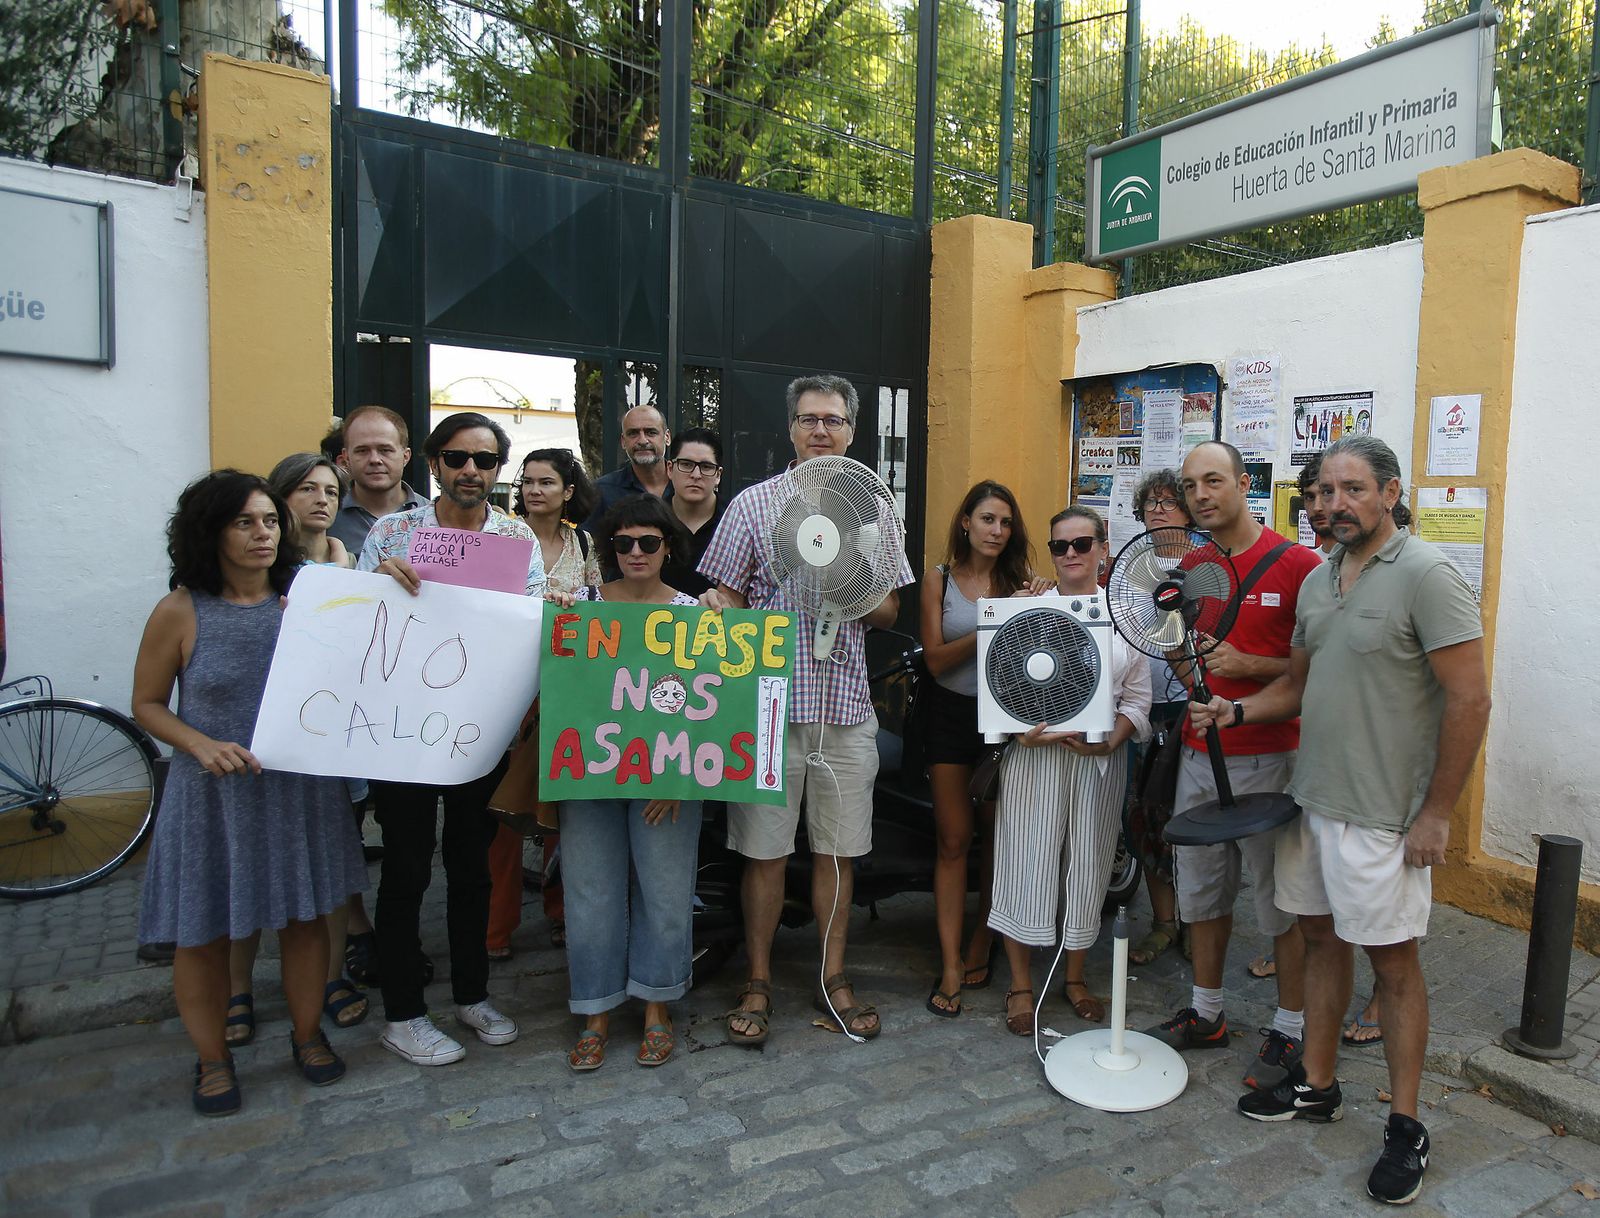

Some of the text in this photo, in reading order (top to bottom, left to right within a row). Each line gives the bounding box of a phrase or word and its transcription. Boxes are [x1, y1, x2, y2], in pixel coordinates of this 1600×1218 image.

[1167, 87, 1458, 184] Colegio de Educación Infantil y Primaria
[1232, 123, 1456, 204] Huerta de Santa Marina
[1106, 220, 1121, 230] JUNTA
[1121, 218, 1128, 227] DE
[0, 290, 45, 322] üe
[1246, 361, 1272, 375] KIDS
[1081, 446, 1114, 457] createca
[417, 531, 482, 547] TENEMOS
[812, 538, 823, 549] fm
[410, 555, 459, 567] ENCLASE
[983, 610, 995, 618] fm
[359, 600, 468, 689] NO
[551, 610, 790, 678] EN CLASE
[611, 667, 723, 721] NOS
[299, 689, 481, 759] CALOR
[550, 722, 755, 787] ASAMOS
